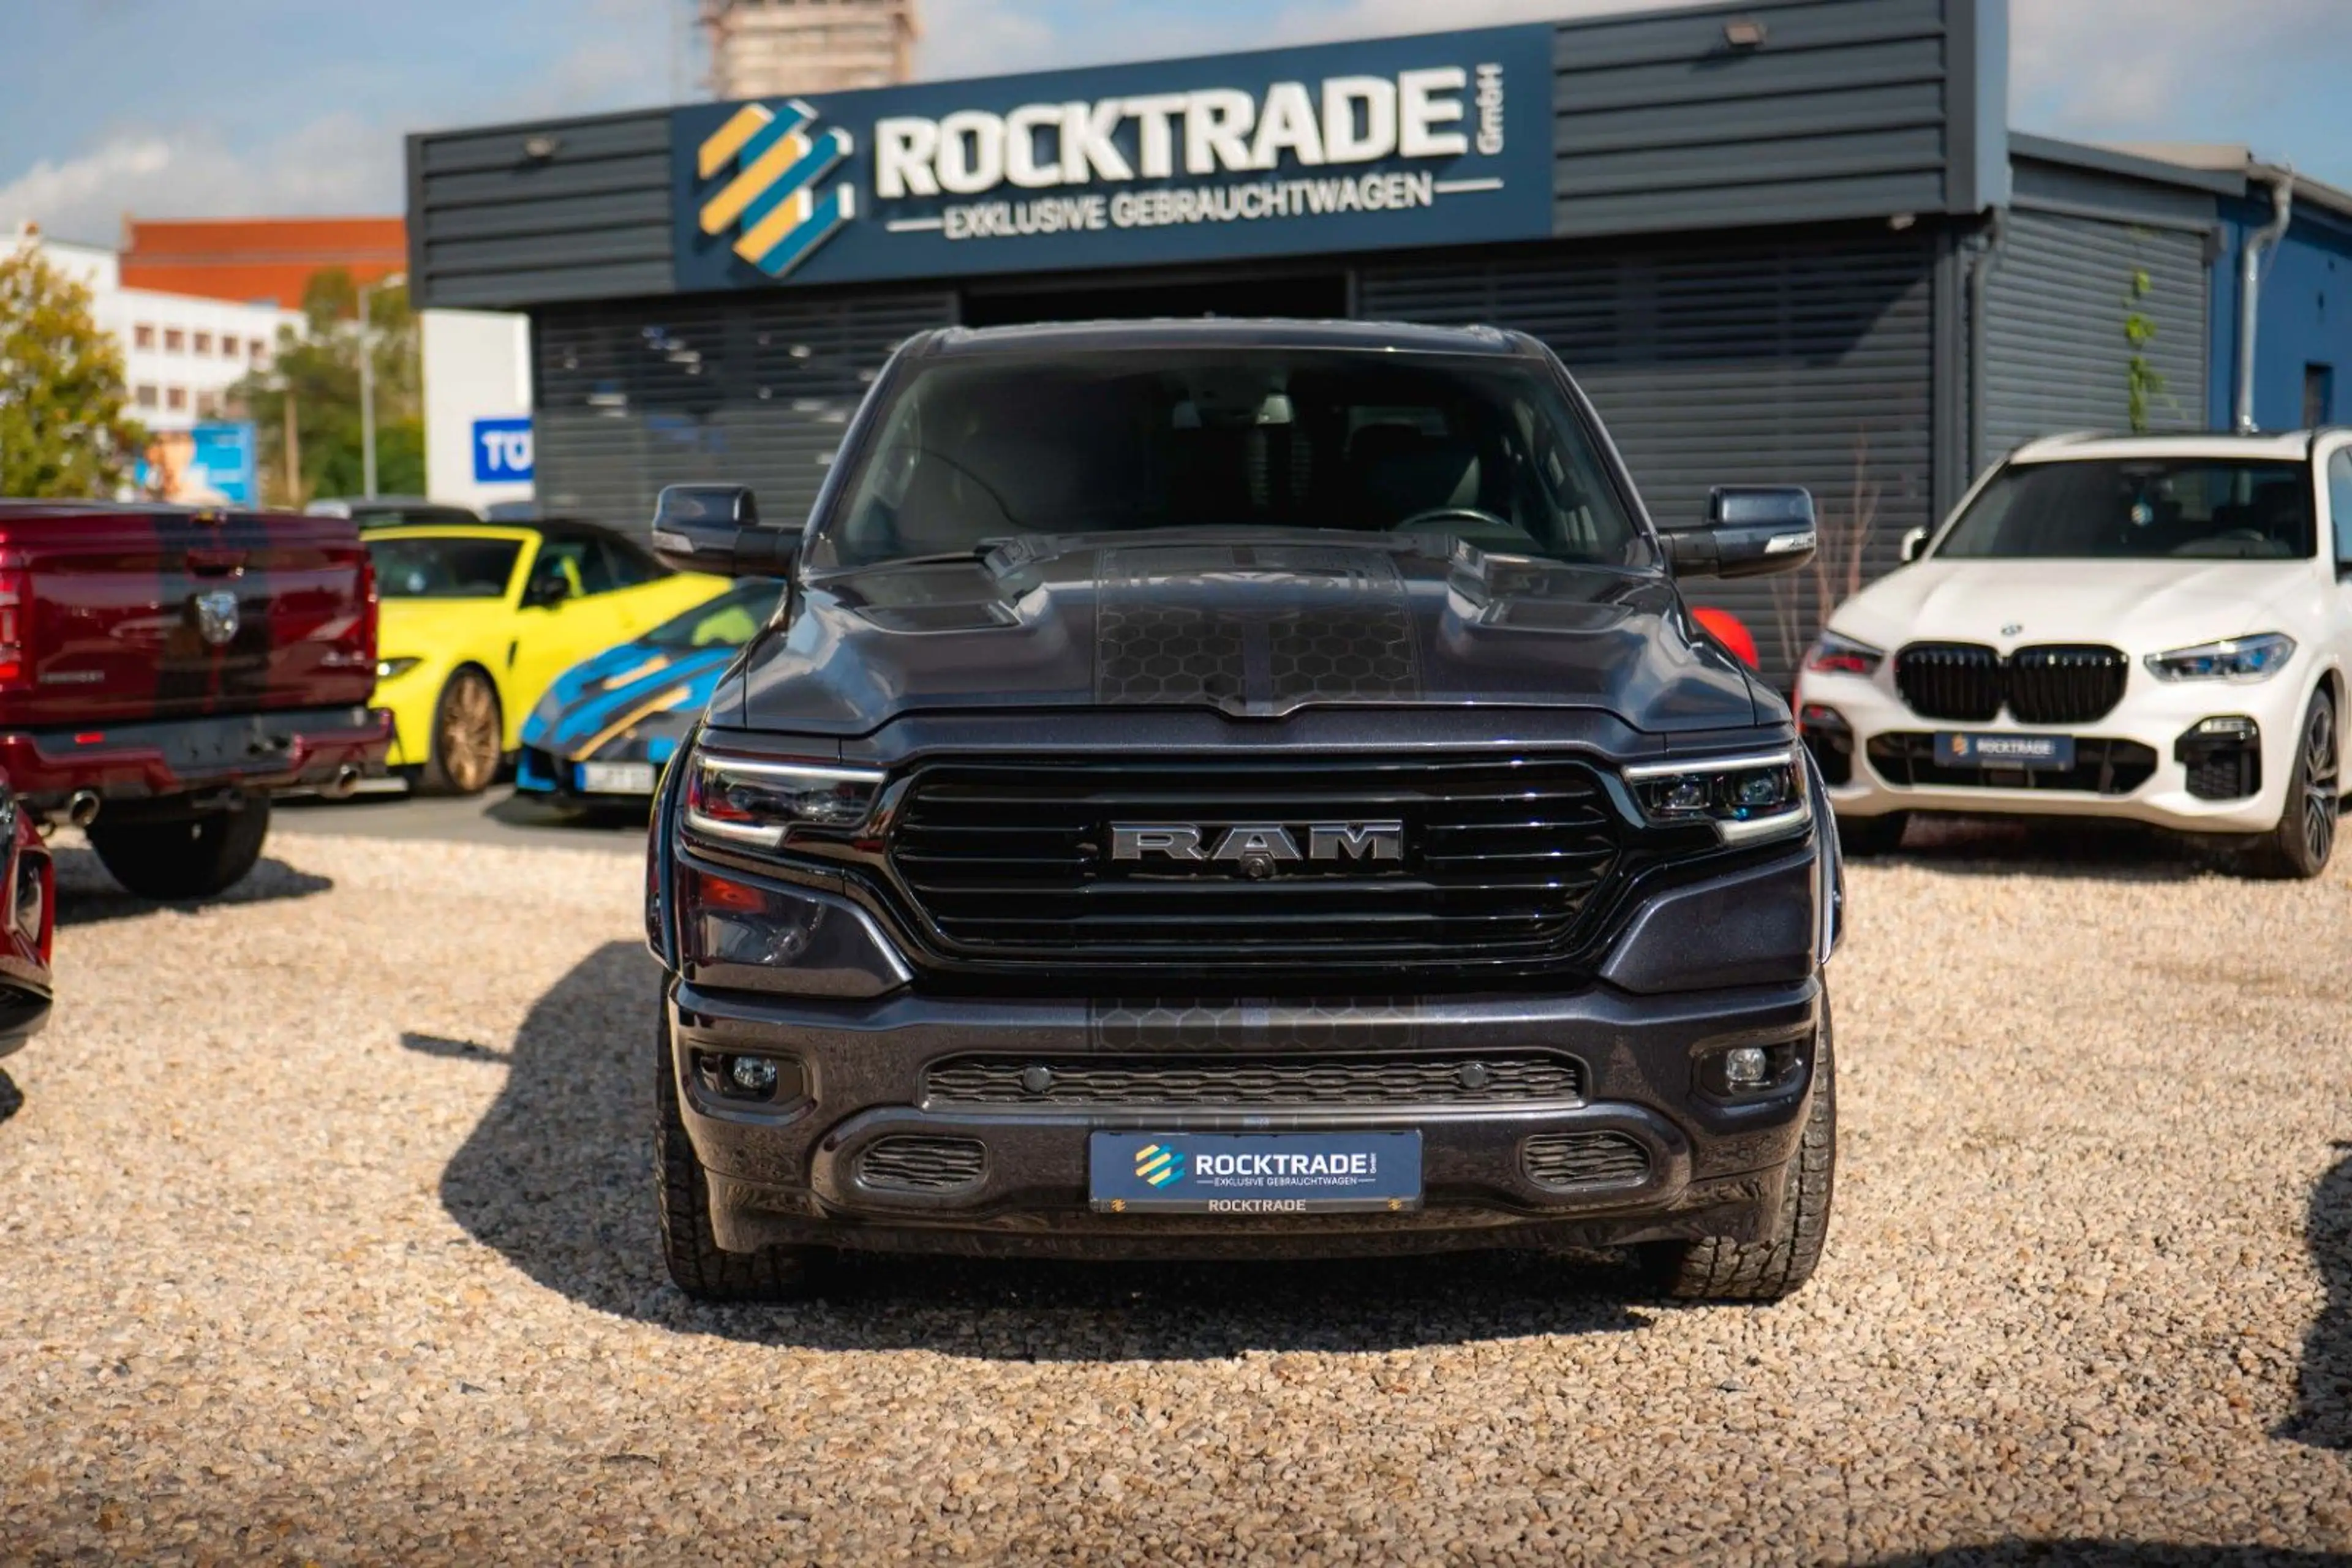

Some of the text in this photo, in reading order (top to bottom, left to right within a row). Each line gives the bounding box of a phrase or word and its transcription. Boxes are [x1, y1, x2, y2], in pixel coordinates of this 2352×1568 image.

[1476, 62, 1504, 155] GmbH
[875, 66, 1469, 198] ROCKTRADE
[944, 171, 1433, 239] EXKLUSIVE GEBRAUCHTWAGEN
[1111, 820, 1404, 860] RAM
[1196, 1154, 1367, 1175] ROCKTRADE
[1214, 1176, 1358, 1187] EXKLUSIVE GEBRAUCHTWAGEN
[1208, 1199, 1306, 1212] ROCKTRADE
